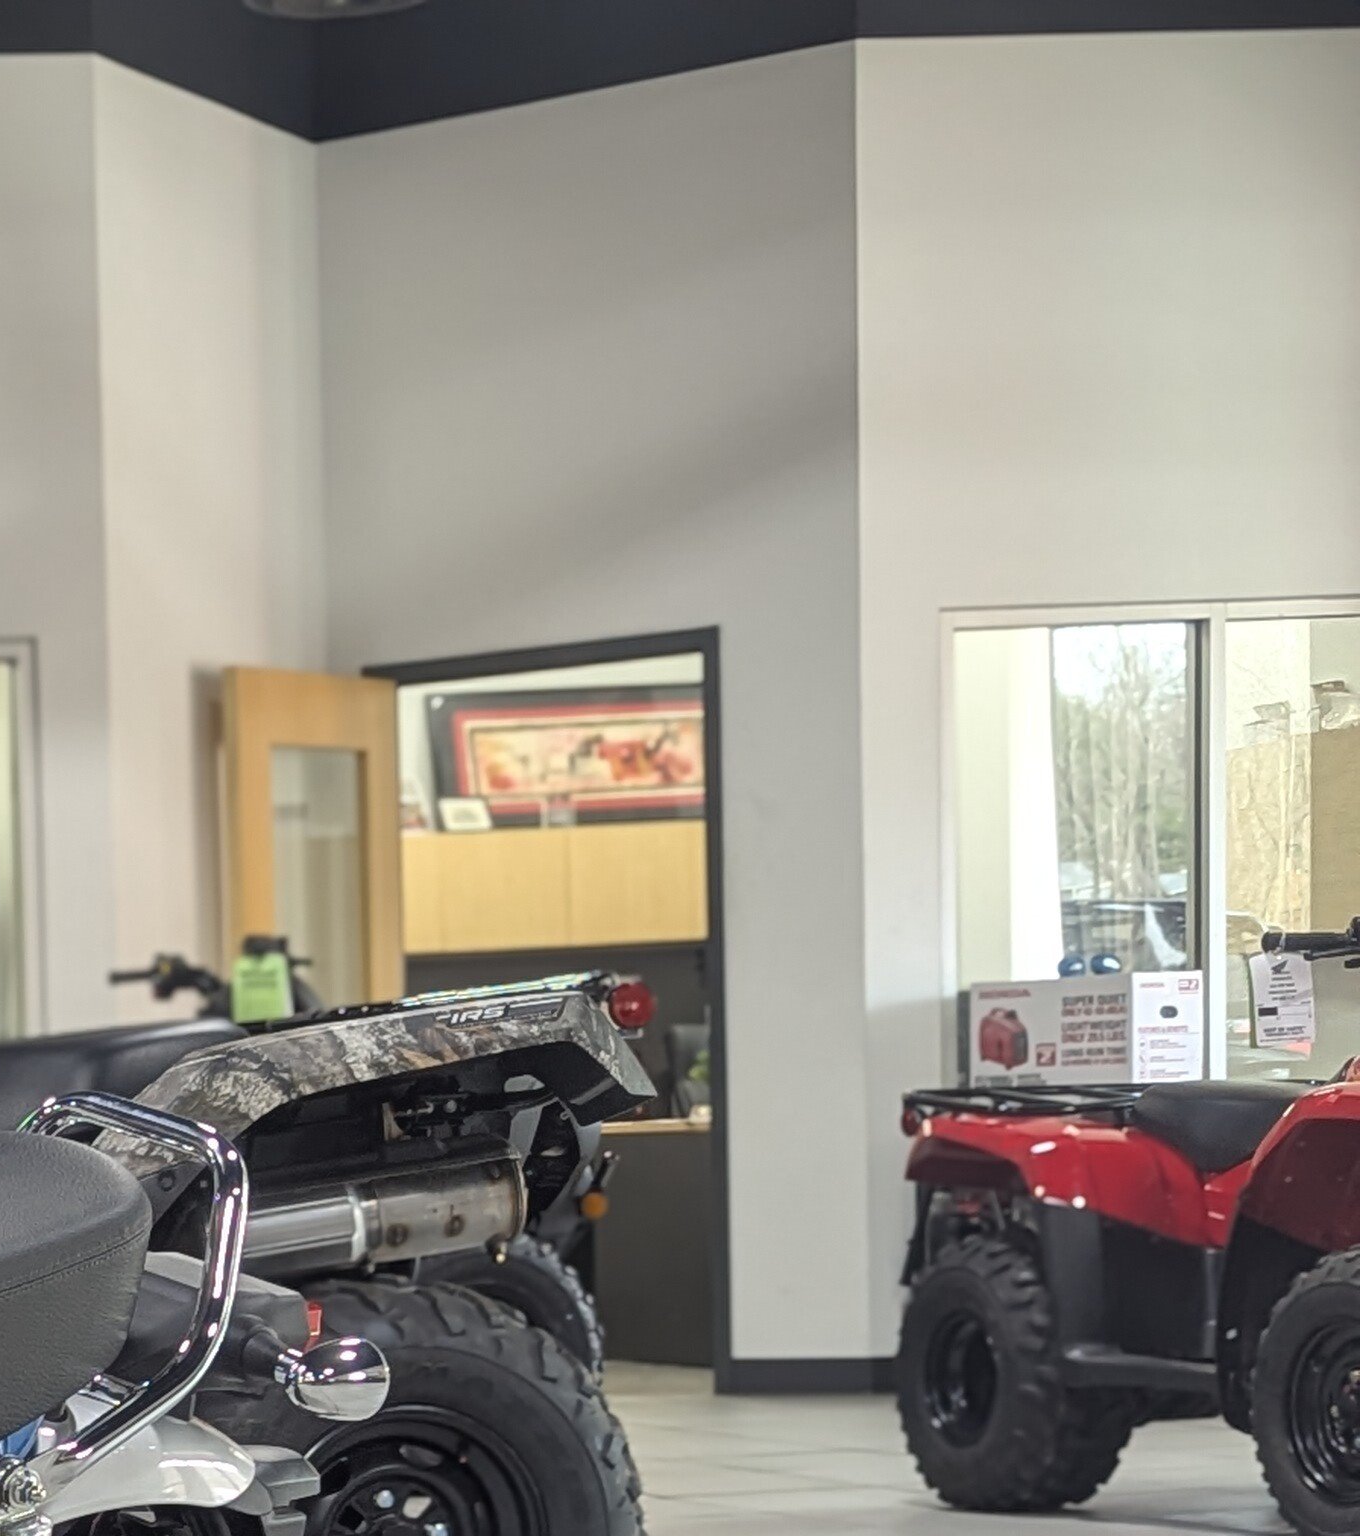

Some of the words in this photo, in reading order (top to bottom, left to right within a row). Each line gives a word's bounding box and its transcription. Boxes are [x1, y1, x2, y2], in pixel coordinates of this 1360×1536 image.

[1062, 996, 1094, 1007] SUPER
[1097, 993, 1128, 1005] QUIET
[449, 1005, 507, 1025] IRS
